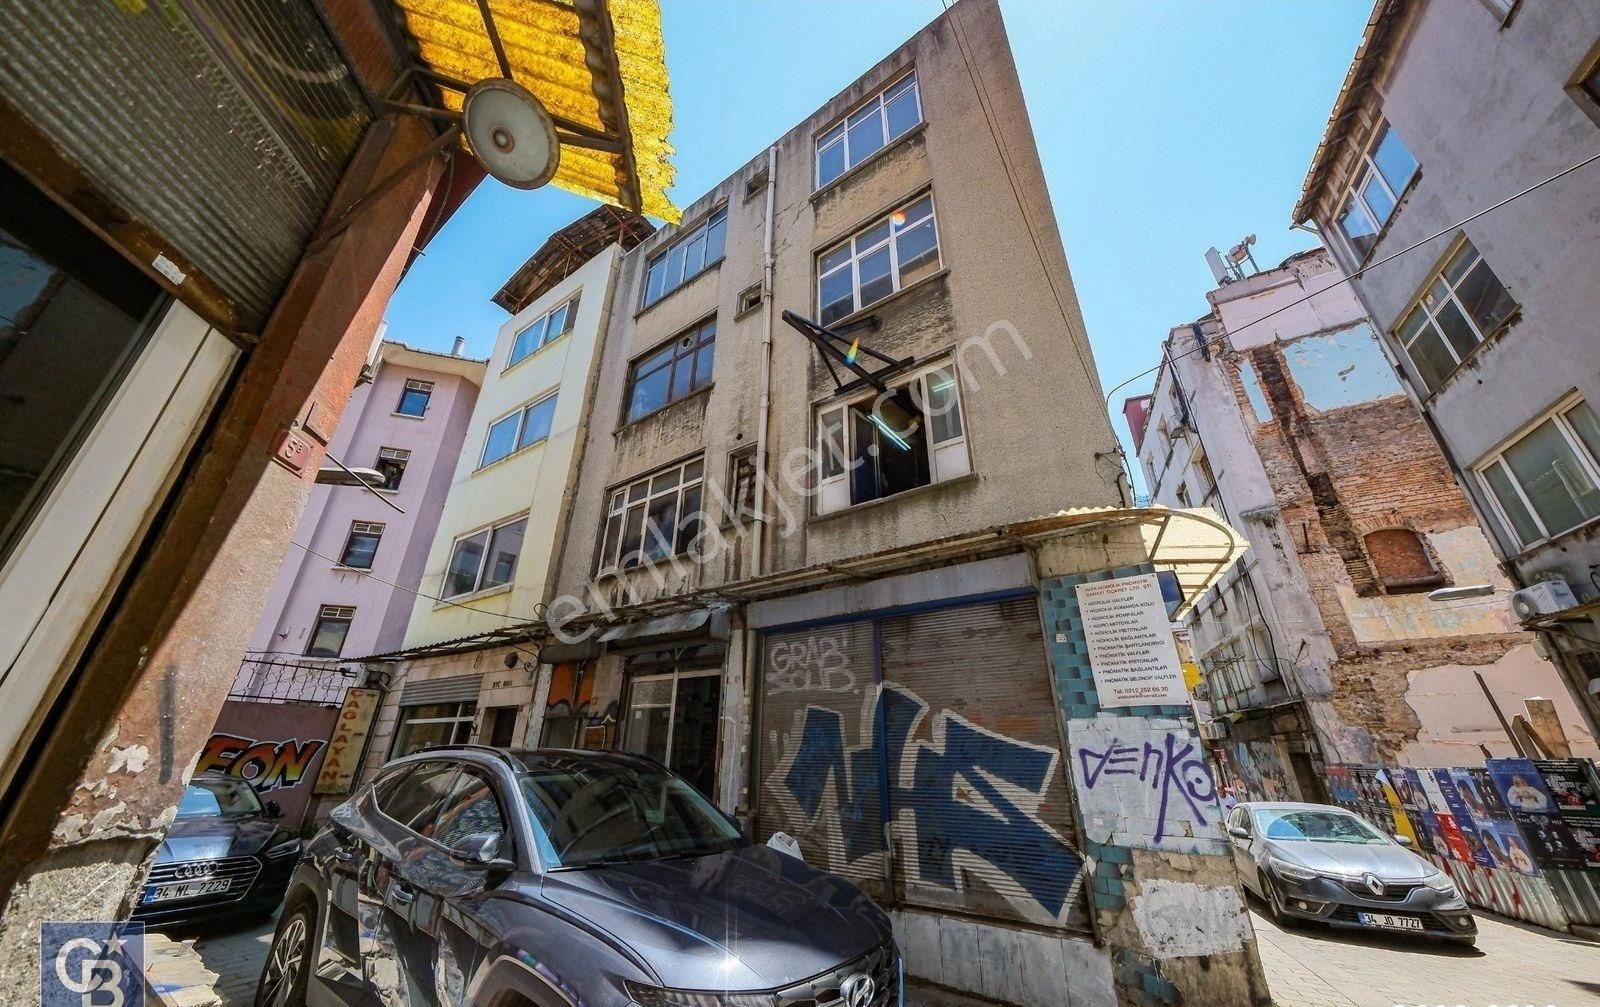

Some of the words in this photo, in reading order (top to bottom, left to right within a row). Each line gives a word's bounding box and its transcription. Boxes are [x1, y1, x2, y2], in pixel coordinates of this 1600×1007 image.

[154, 886, 169, 900] 34
[1364, 914, 1377, 924] 34
[1397, 917, 1421, 929] 7727
